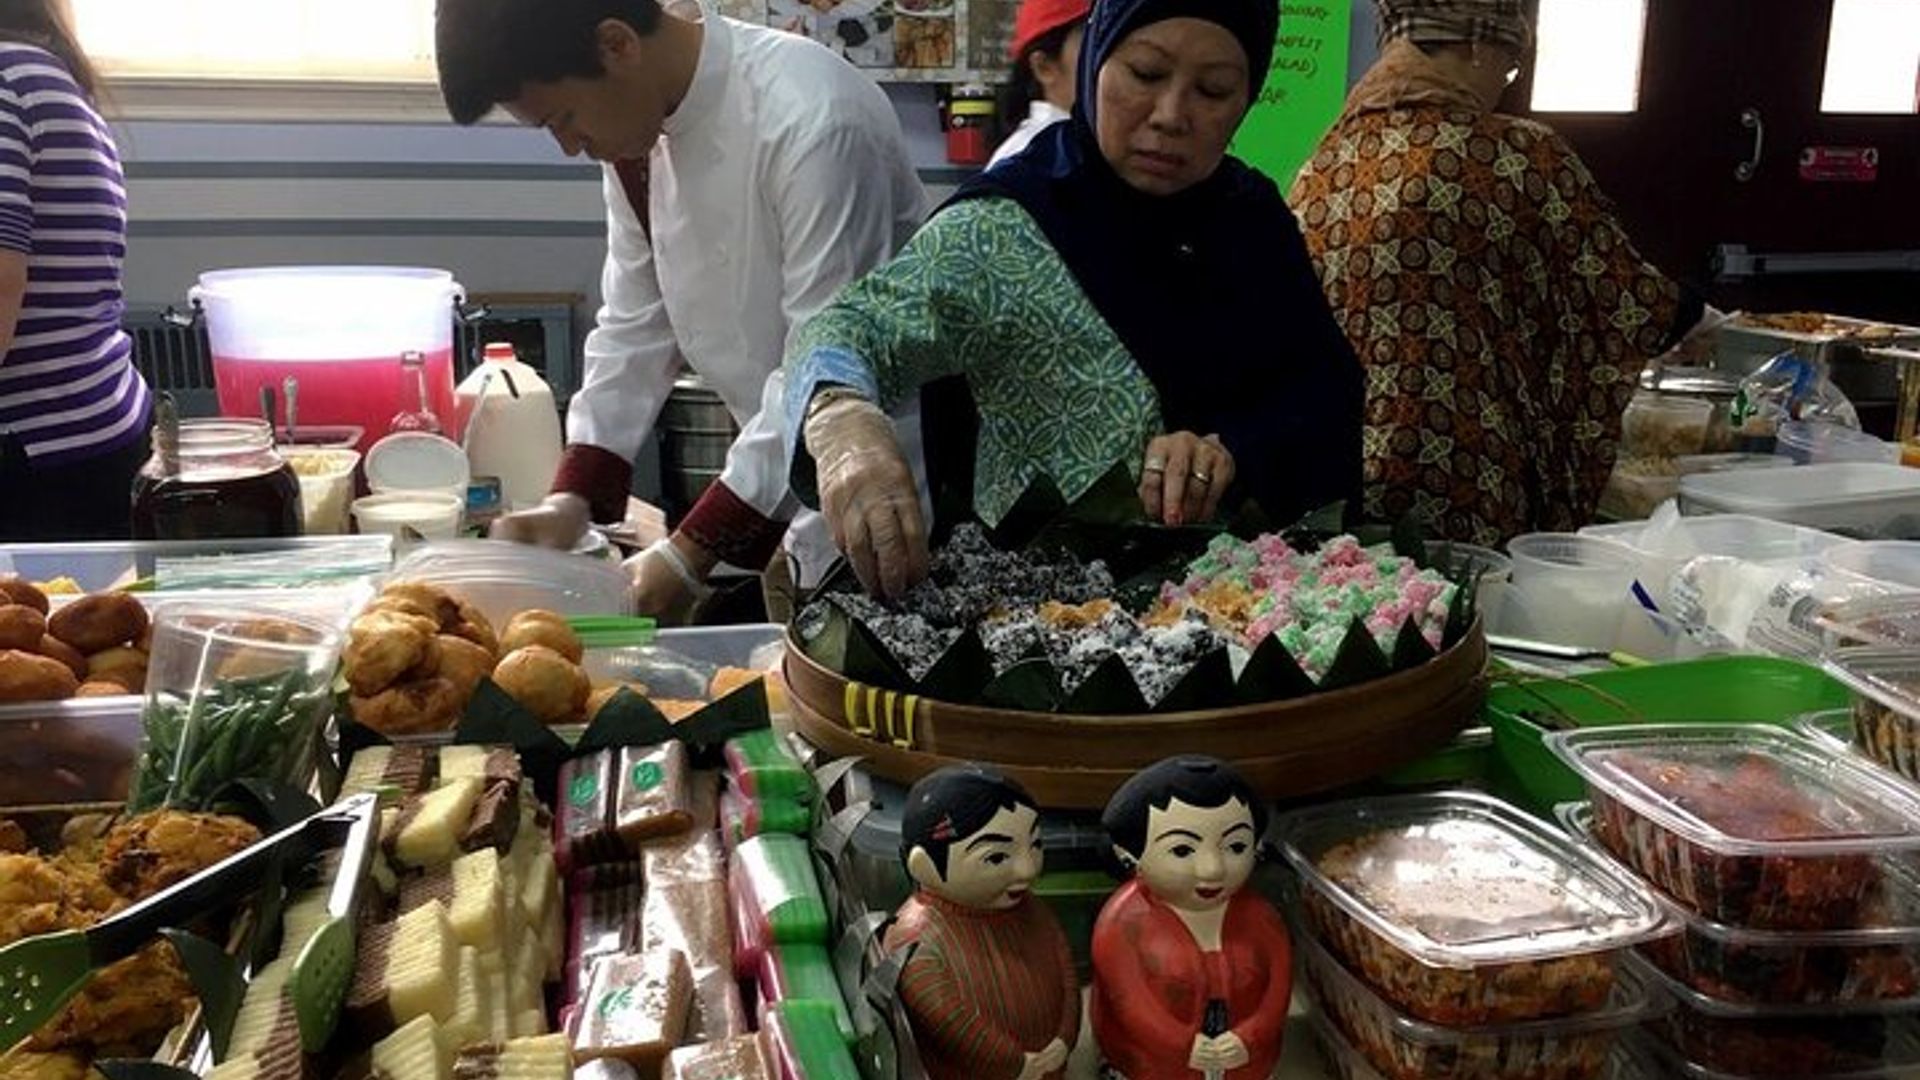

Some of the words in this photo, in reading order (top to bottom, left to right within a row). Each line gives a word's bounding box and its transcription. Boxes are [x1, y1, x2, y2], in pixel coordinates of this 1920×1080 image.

[1278, 35, 1323, 52] MPLIT
[1272, 57, 1319, 79] ALAD)
[1259, 87, 1289, 104] AR
